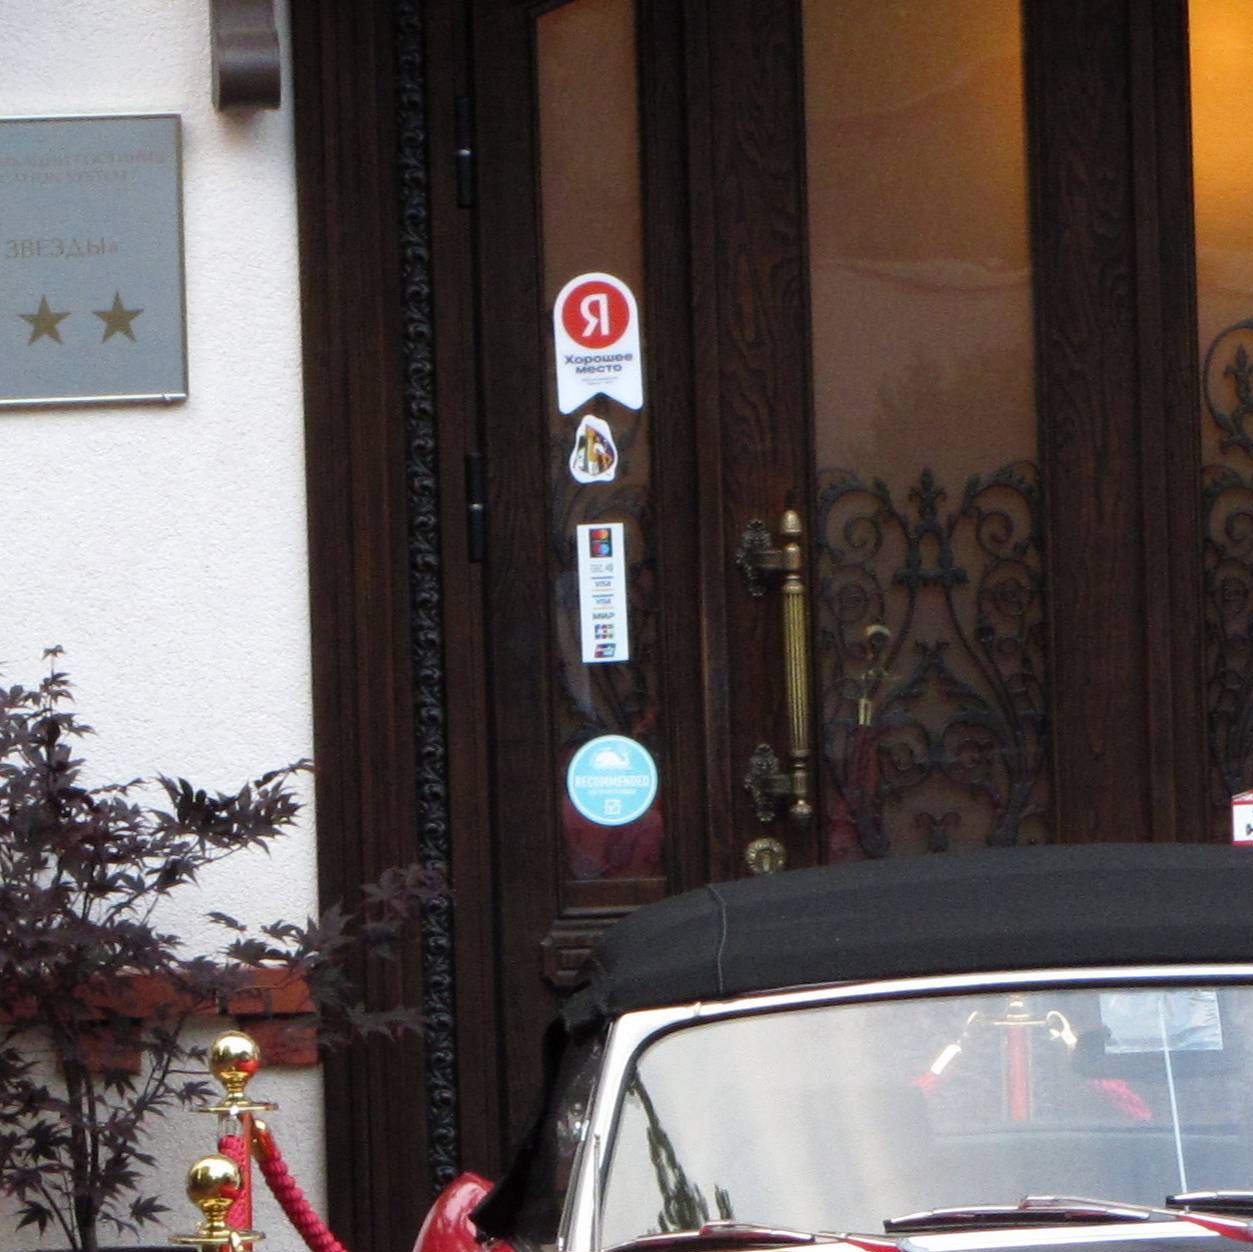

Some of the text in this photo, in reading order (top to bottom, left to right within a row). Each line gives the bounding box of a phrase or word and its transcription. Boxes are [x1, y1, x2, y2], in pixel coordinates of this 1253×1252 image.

[580, 293, 611, 338] Я
[564, 353, 633, 365] Хорошее
[576, 364, 623, 374] место
